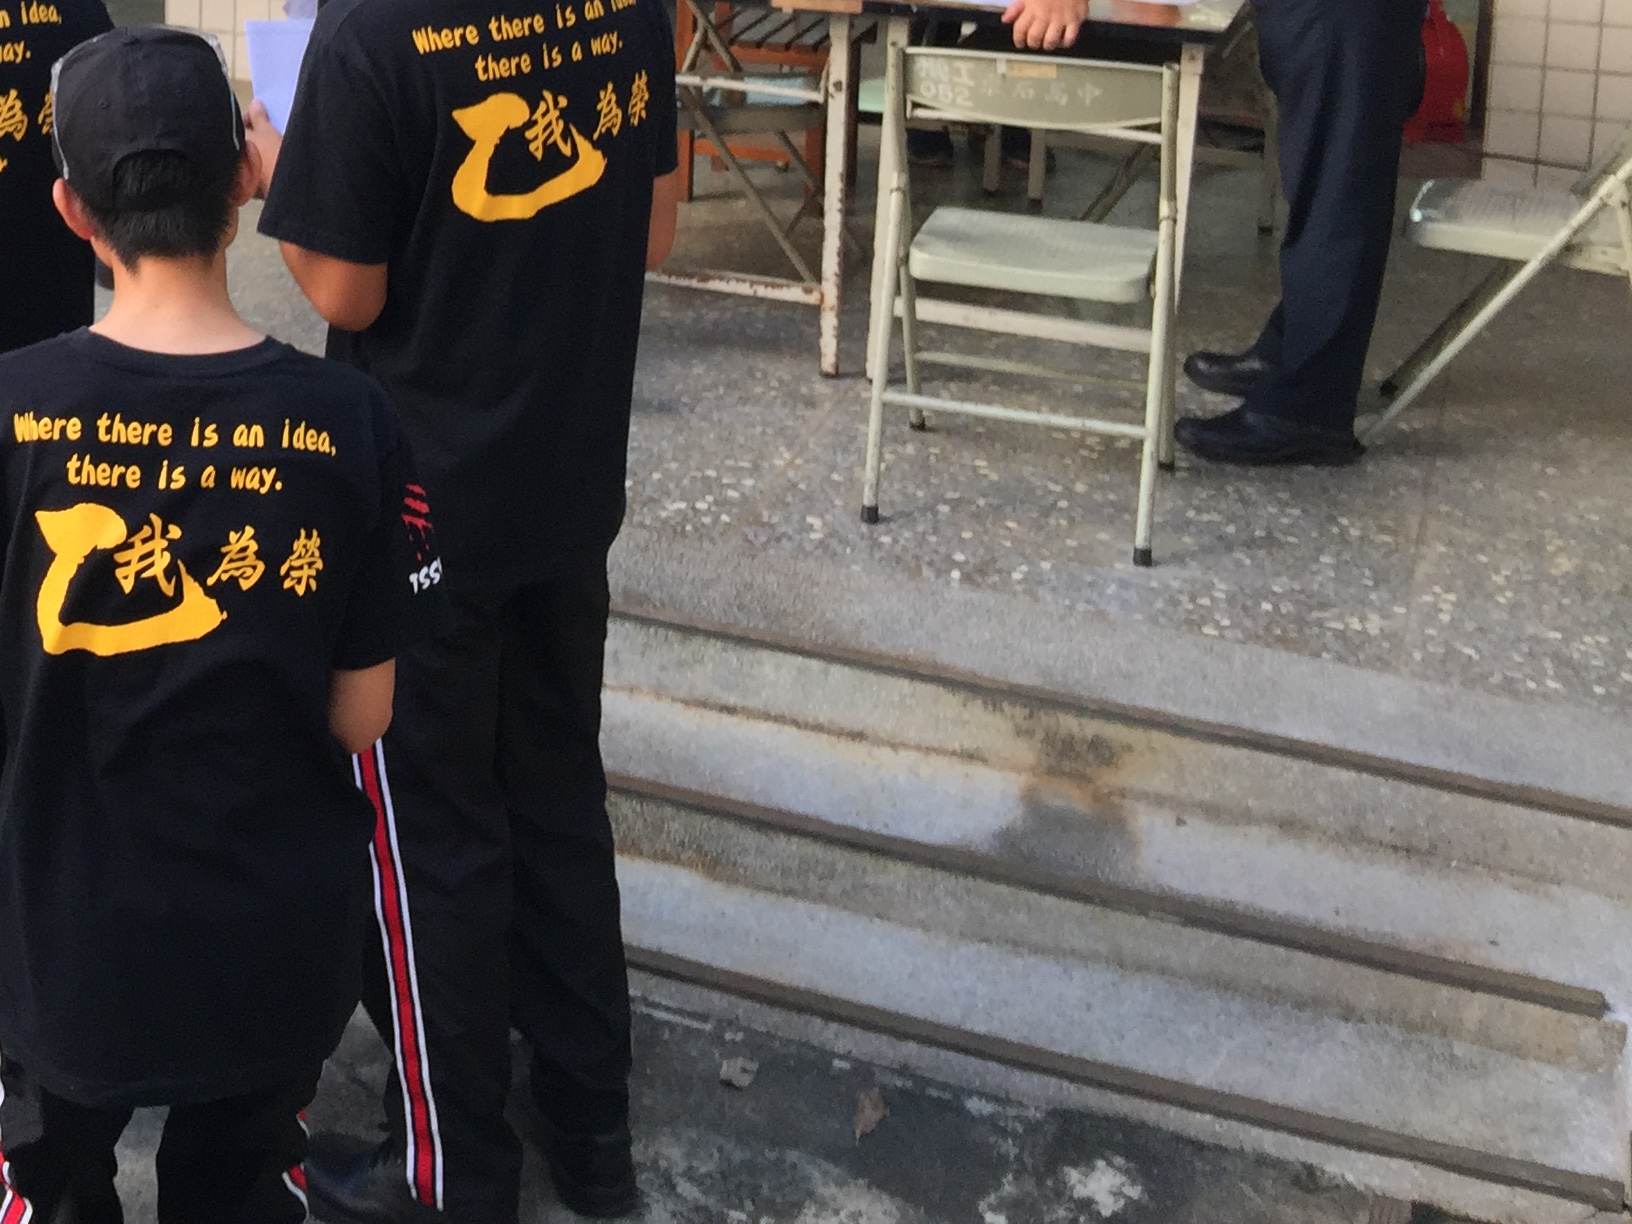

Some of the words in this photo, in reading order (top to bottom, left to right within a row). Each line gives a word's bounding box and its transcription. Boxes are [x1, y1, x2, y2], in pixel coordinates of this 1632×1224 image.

[21, 1, 63, 25] idea,
[411, 25, 480, 55] Where
[488, 14, 545, 43] there
[555, 2, 576, 30] is
[475, 53, 532, 82] there
[542, 45, 562, 69] is
[571, 41, 583, 63] a
[590, 30, 624, 57] way.
[13, 412, 82, 444] Where
[97, 412, 173, 447] there
[191, 417, 219, 449] is
[233, 423, 265, 449] an
[282, 418, 337, 457] idea,
[66, 454, 142, 490] there
[158, 460, 187, 491] is
[200, 464, 216, 489] a
[230, 465, 283, 495] way.
